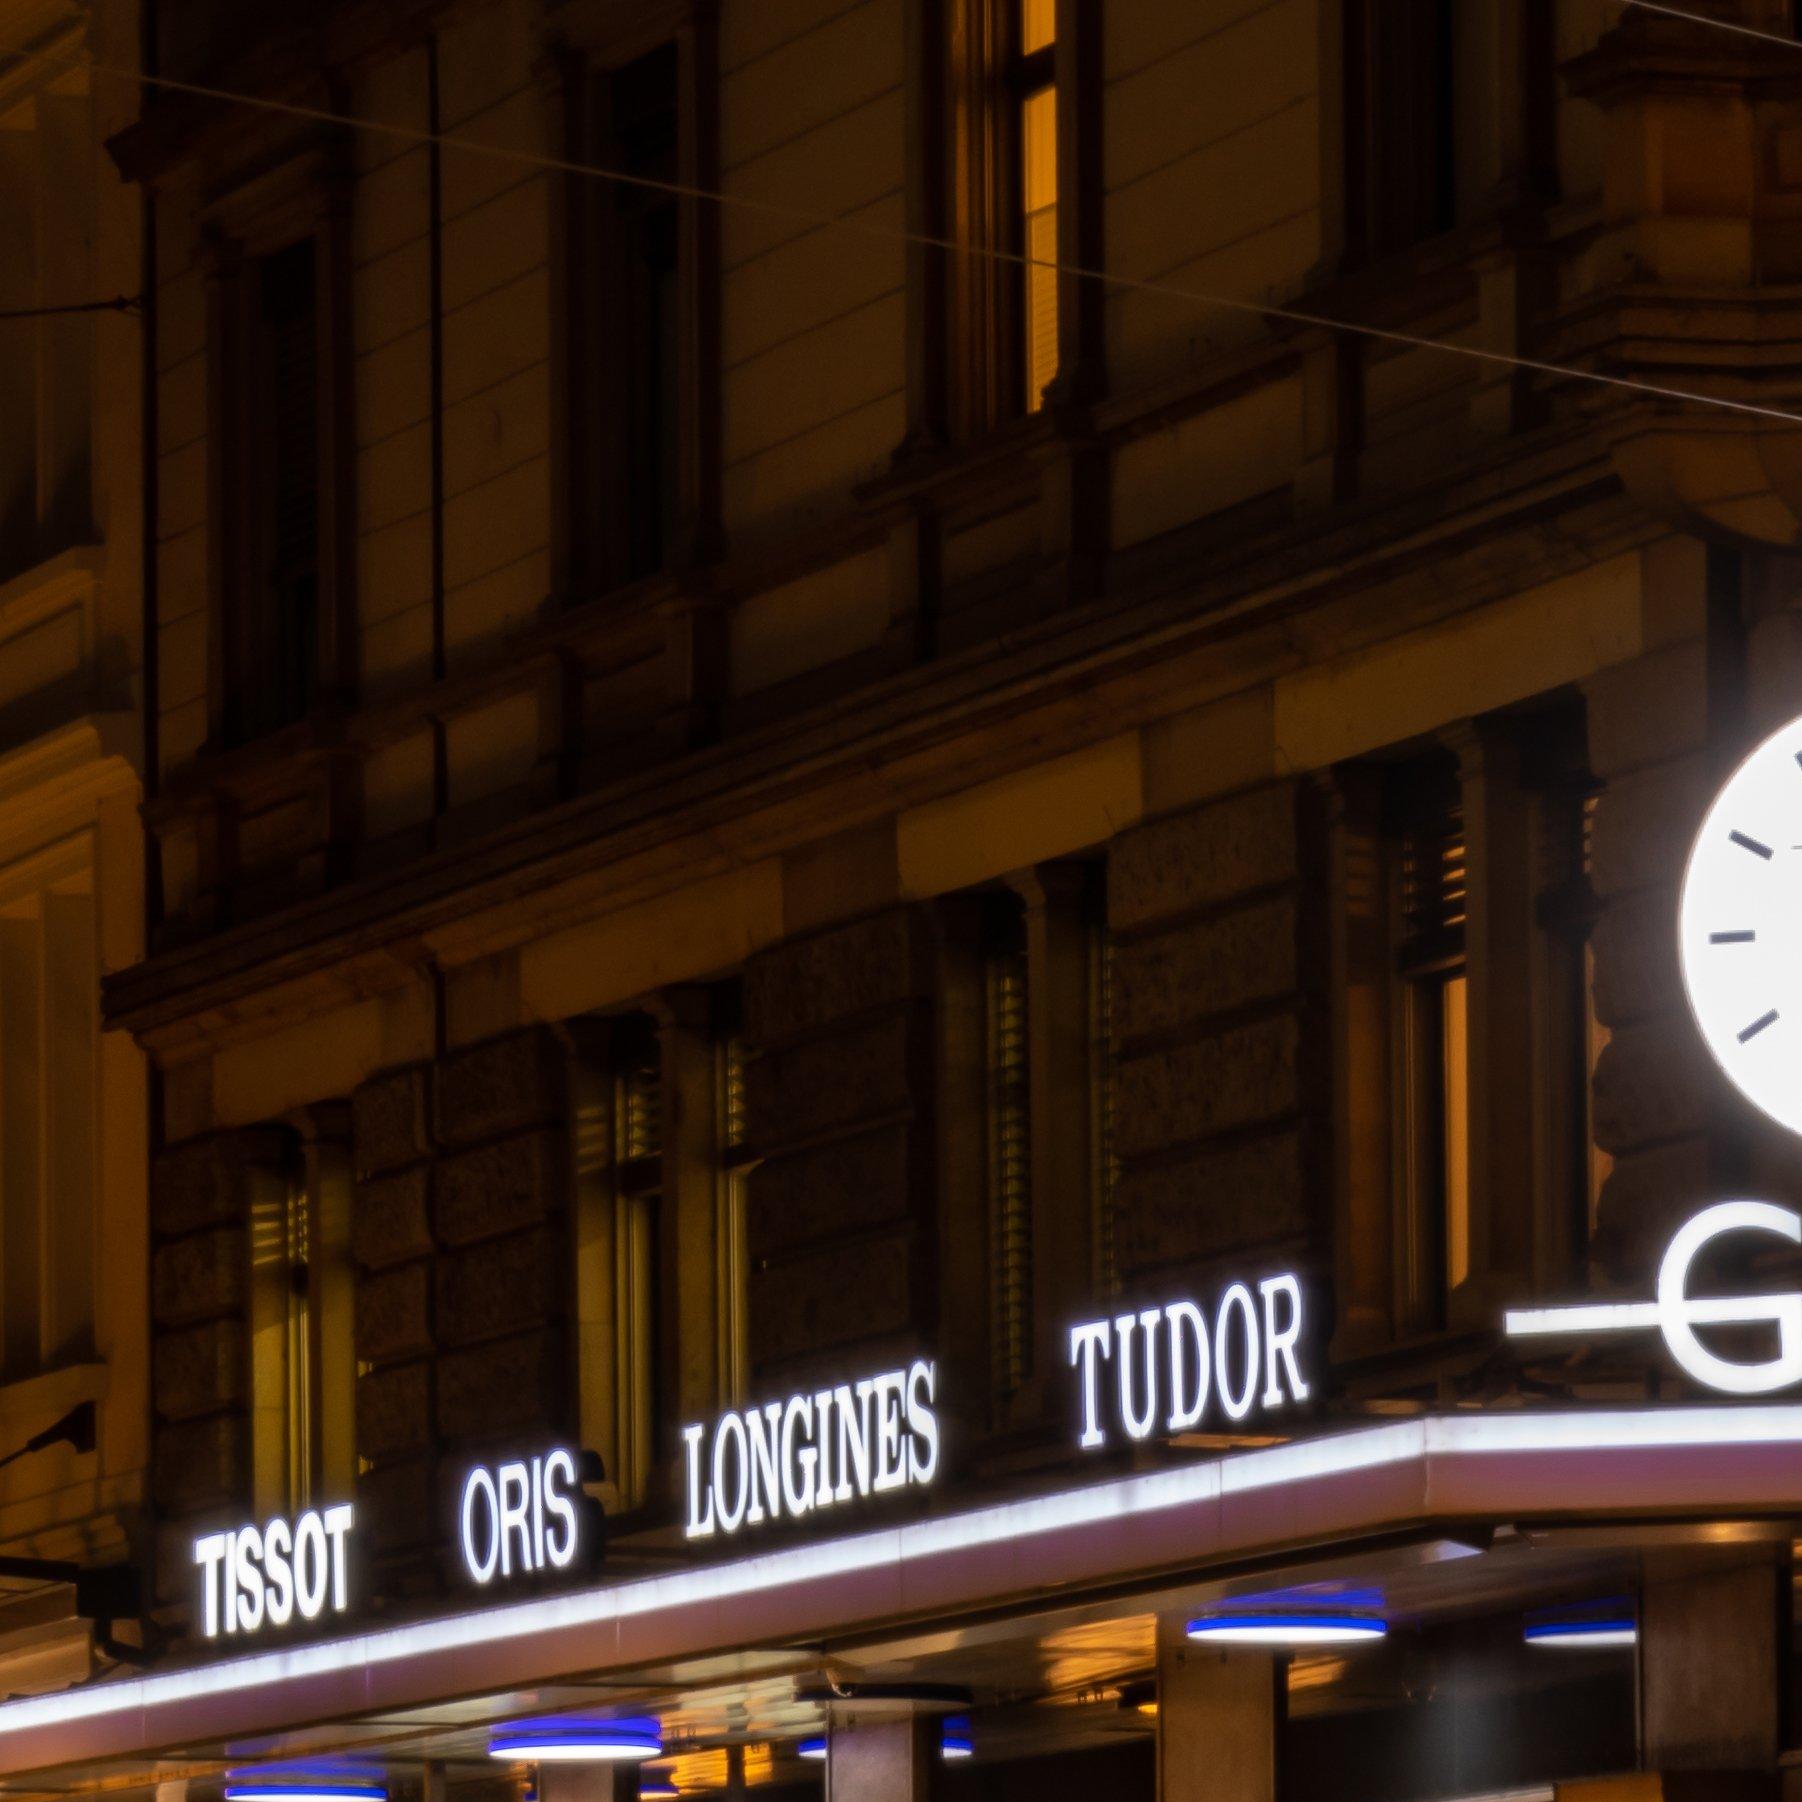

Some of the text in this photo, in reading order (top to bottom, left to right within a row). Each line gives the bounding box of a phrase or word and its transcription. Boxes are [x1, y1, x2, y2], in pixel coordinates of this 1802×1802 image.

[1069, 1271, 1310, 1450] TUDOR
[460, 1446, 580, 1585] ORIS
[684, 1359, 940, 1539] LONGINES
[195, 1503, 353, 1639] TISSOT
